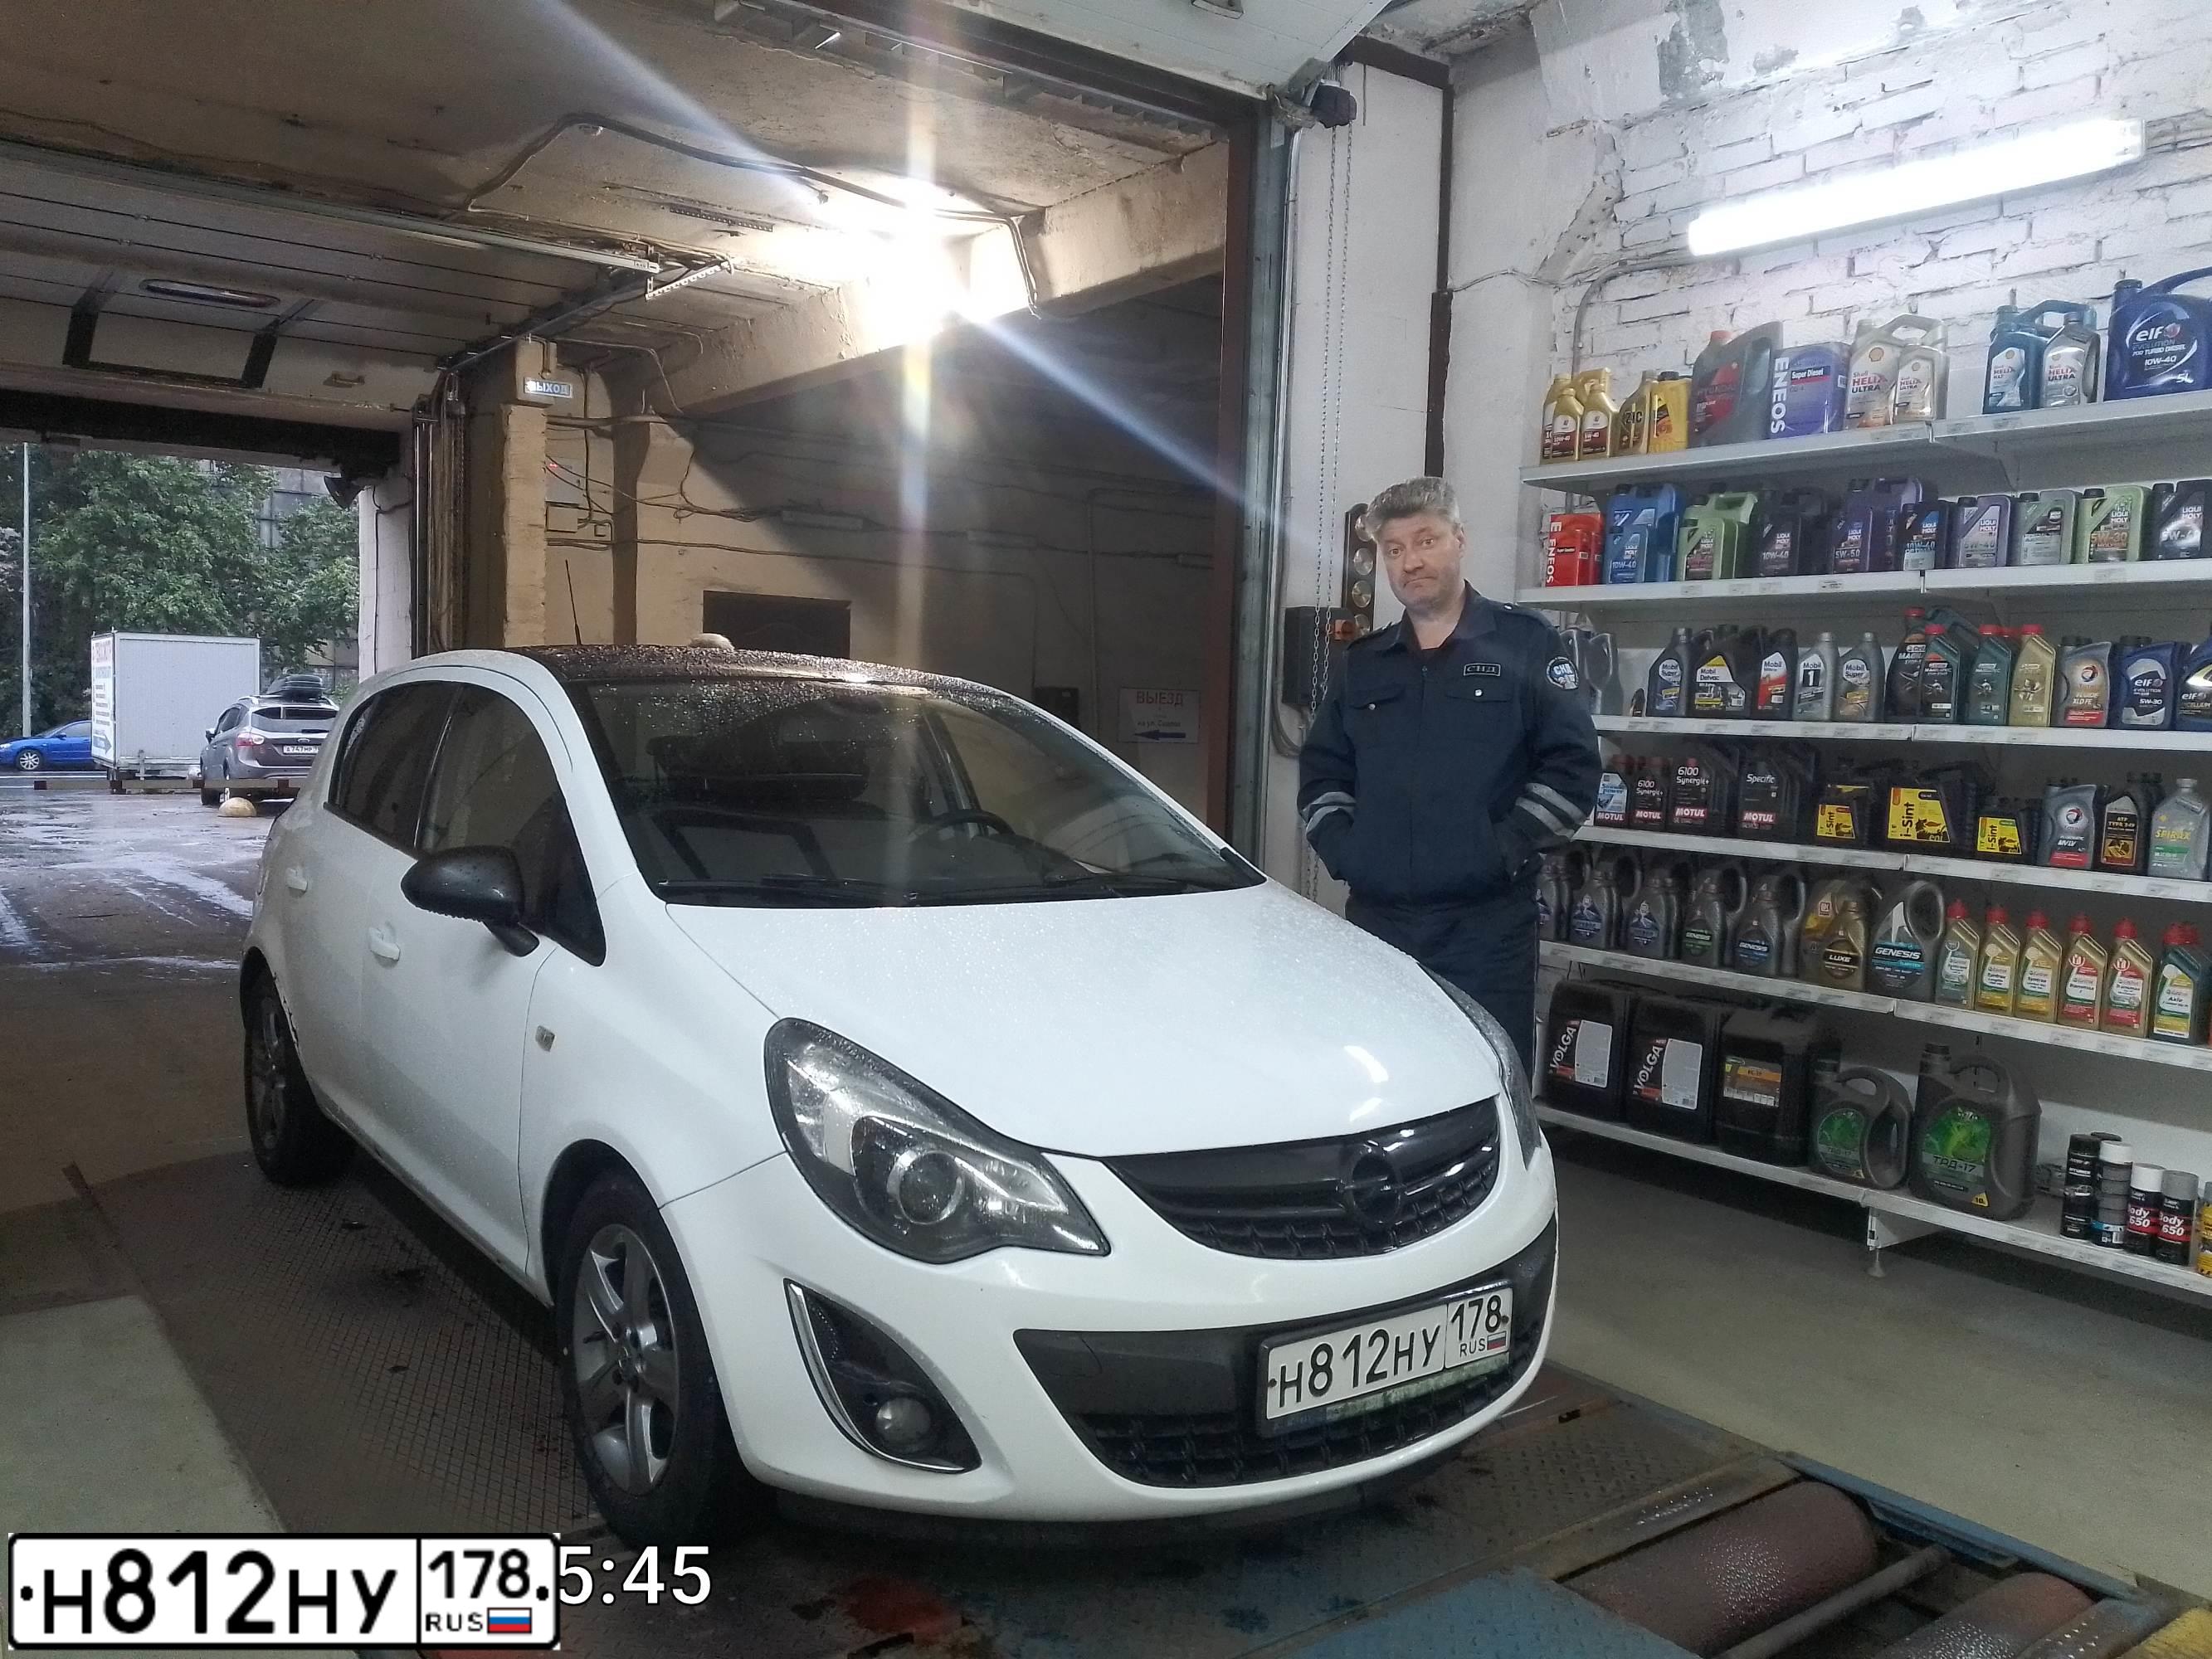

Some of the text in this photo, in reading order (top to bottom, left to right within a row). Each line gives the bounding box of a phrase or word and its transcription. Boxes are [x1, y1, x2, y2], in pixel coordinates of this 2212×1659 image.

[2136, 326, 2164, 342] elf
[2145, 356, 2177, 366] 10W-40
[1791, 367, 1824, 379] Super Diesel
[2048, 373, 2076, 382] ULTRA
[1852, 375, 1887, 387] HELIX
[1771, 357, 1790, 434] ENEOS
[1851, 385, 1880, 394] ULTRA
[1625, 411, 1643, 424] ZIC
[1834, 549, 1861, 558] 5W-50
[1807, 670, 1815, 686] 1
[2134, 677, 2152, 687] elf
[1136, 690, 1184, 706] ВЫЕЗД
[2181, 692, 2198, 700] elf
[1678, 766, 1699, 776] 6100
[1638, 780, 1655, 788] 6100
[1746, 773, 1776, 784] Specific
[1596, 812, 1625, 821] MOTUL
[1635, 810, 1662, 819] MOTUL
[1675, 807, 1706, 817] MOTUL
[1743, 812, 1775, 822] MOTUL
[1825, 811, 1835, 835] i-Sint
[1899, 801, 1915, 838] i-Sint
[1985, 824, 1999, 851] i-Sint
[1829, 954, 1853, 964] LUXE
[1874, 946, 1922, 960] GENESIS
[1549, 1026, 1577, 1069] VOLGA
[1634, 1045, 1664, 1090] VOLGA
[2129, 1216, 2151, 1228] 650
[2162, 1224, 2185, 1237] 650
[1450, 1294, 1503, 1341] 178
[1459, 1338, 1486, 1358] RUS
